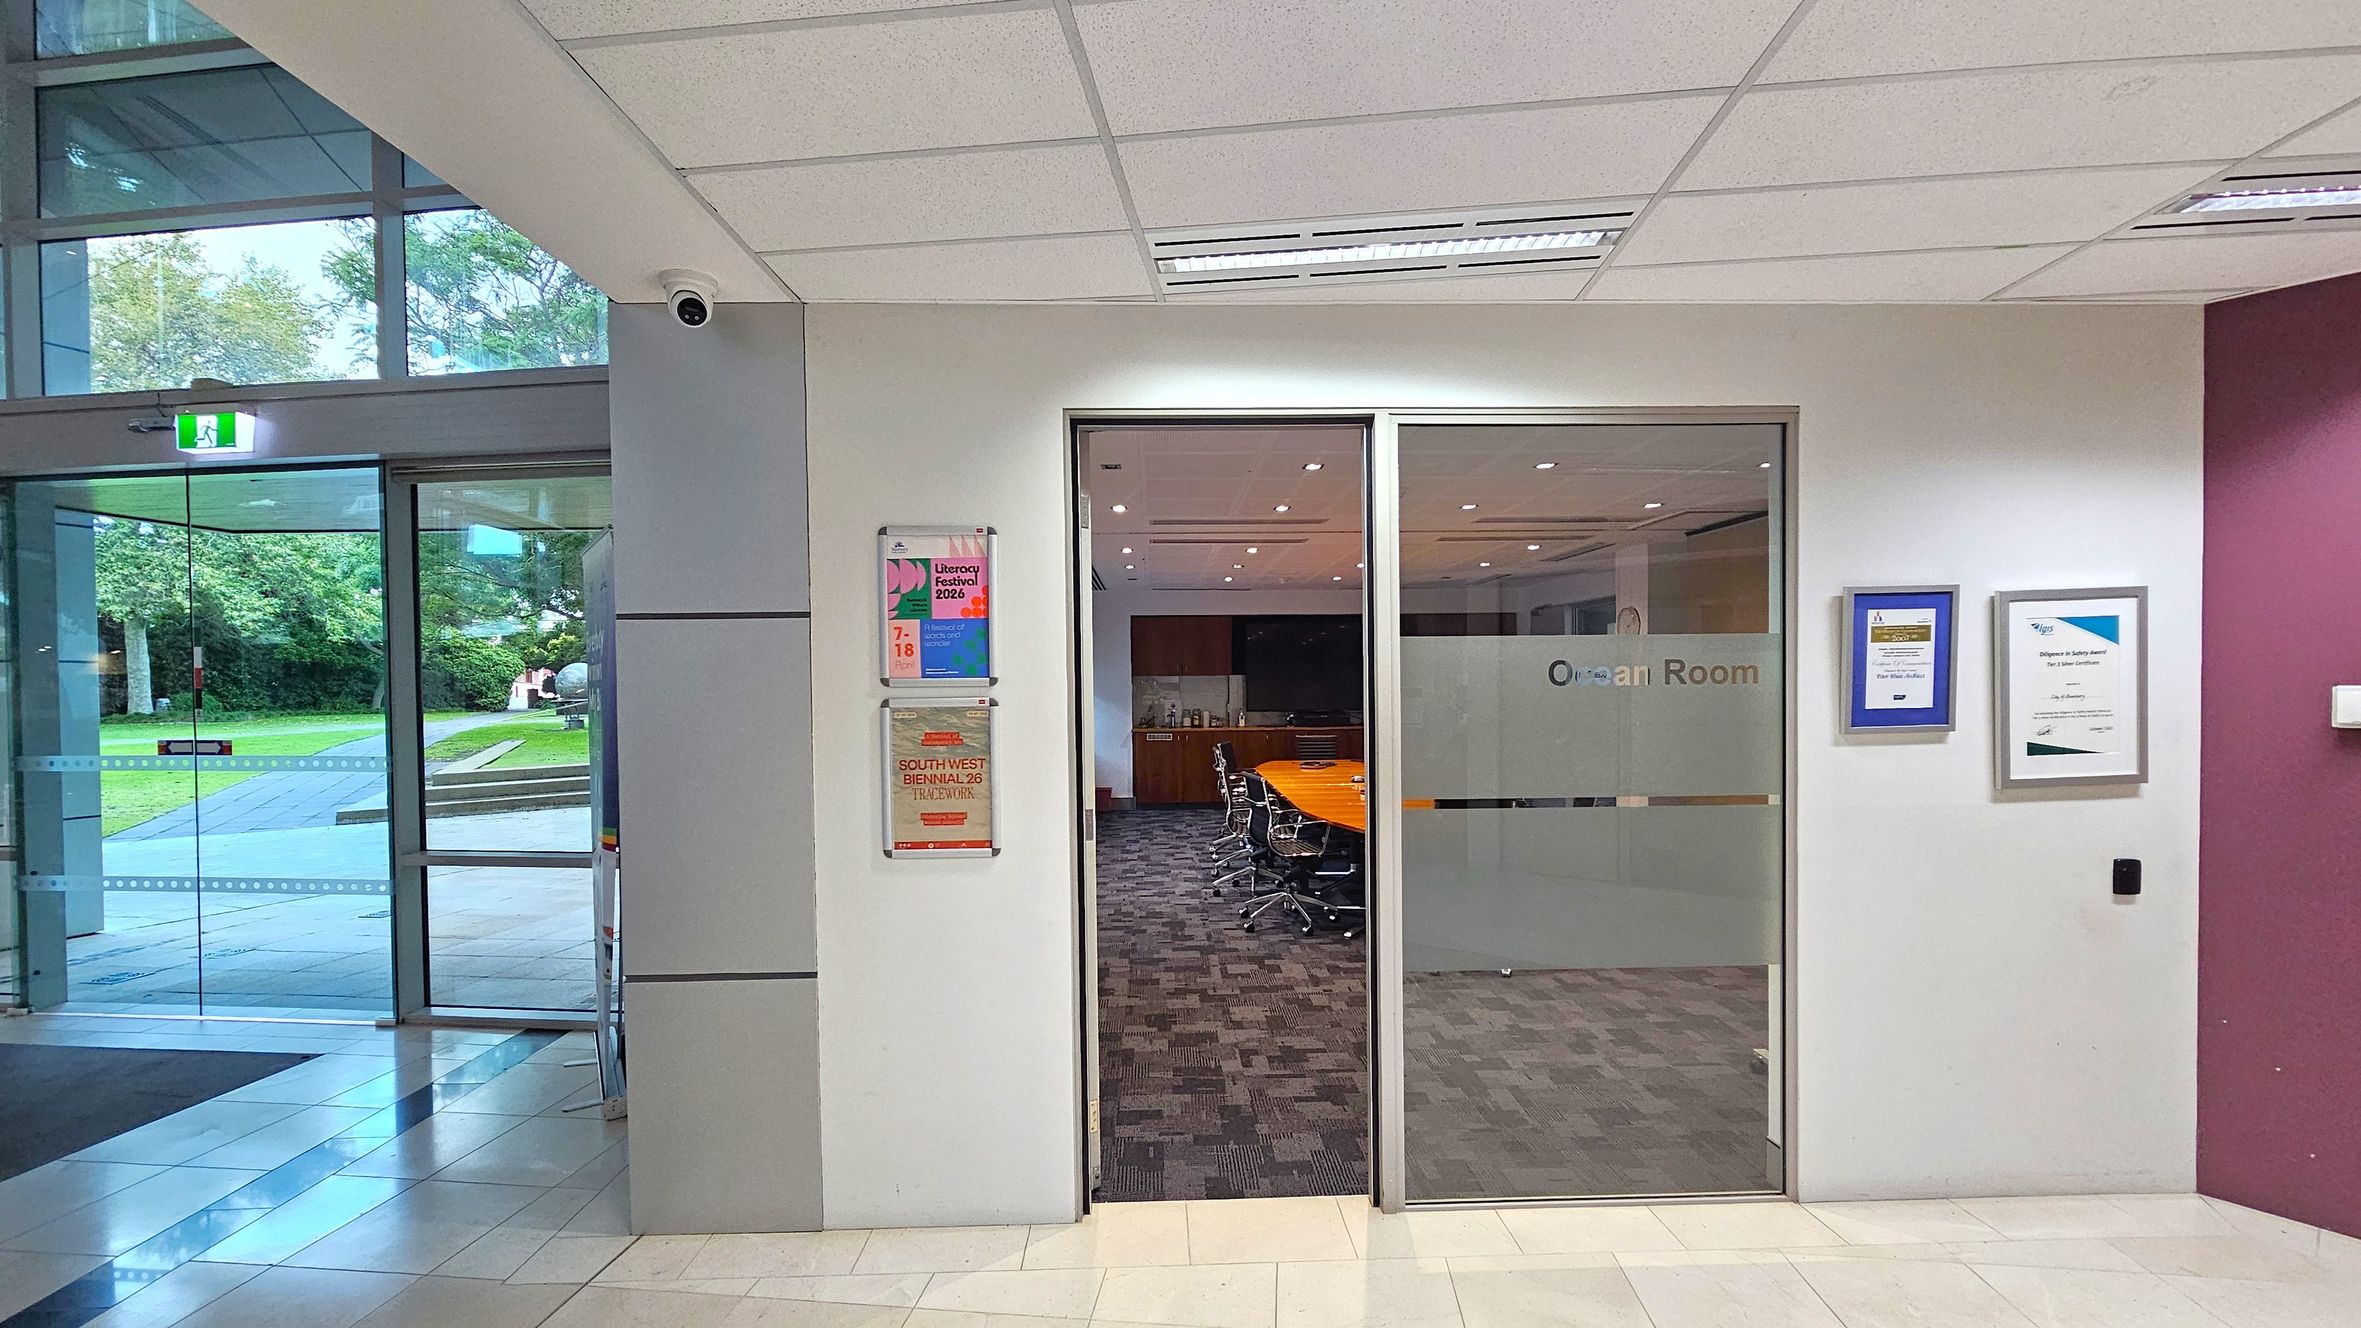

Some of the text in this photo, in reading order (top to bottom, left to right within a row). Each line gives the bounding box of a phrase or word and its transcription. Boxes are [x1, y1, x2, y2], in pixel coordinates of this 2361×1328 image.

[934, 563, 980, 575] Literacy
[935, 576, 978, 587] Festival
[935, 588, 965, 599] 2026
[893, 626, 909, 640] 7-
[895, 643, 914, 657] 18
[895, 661, 915, 671] April
[1664, 658, 1759, 685] Room
[899, 758, 986, 771] SOUTH WEST
[903, 773, 983, 785] BIENNIAL 26
[912, 786, 975, 800] TRACEWORK
